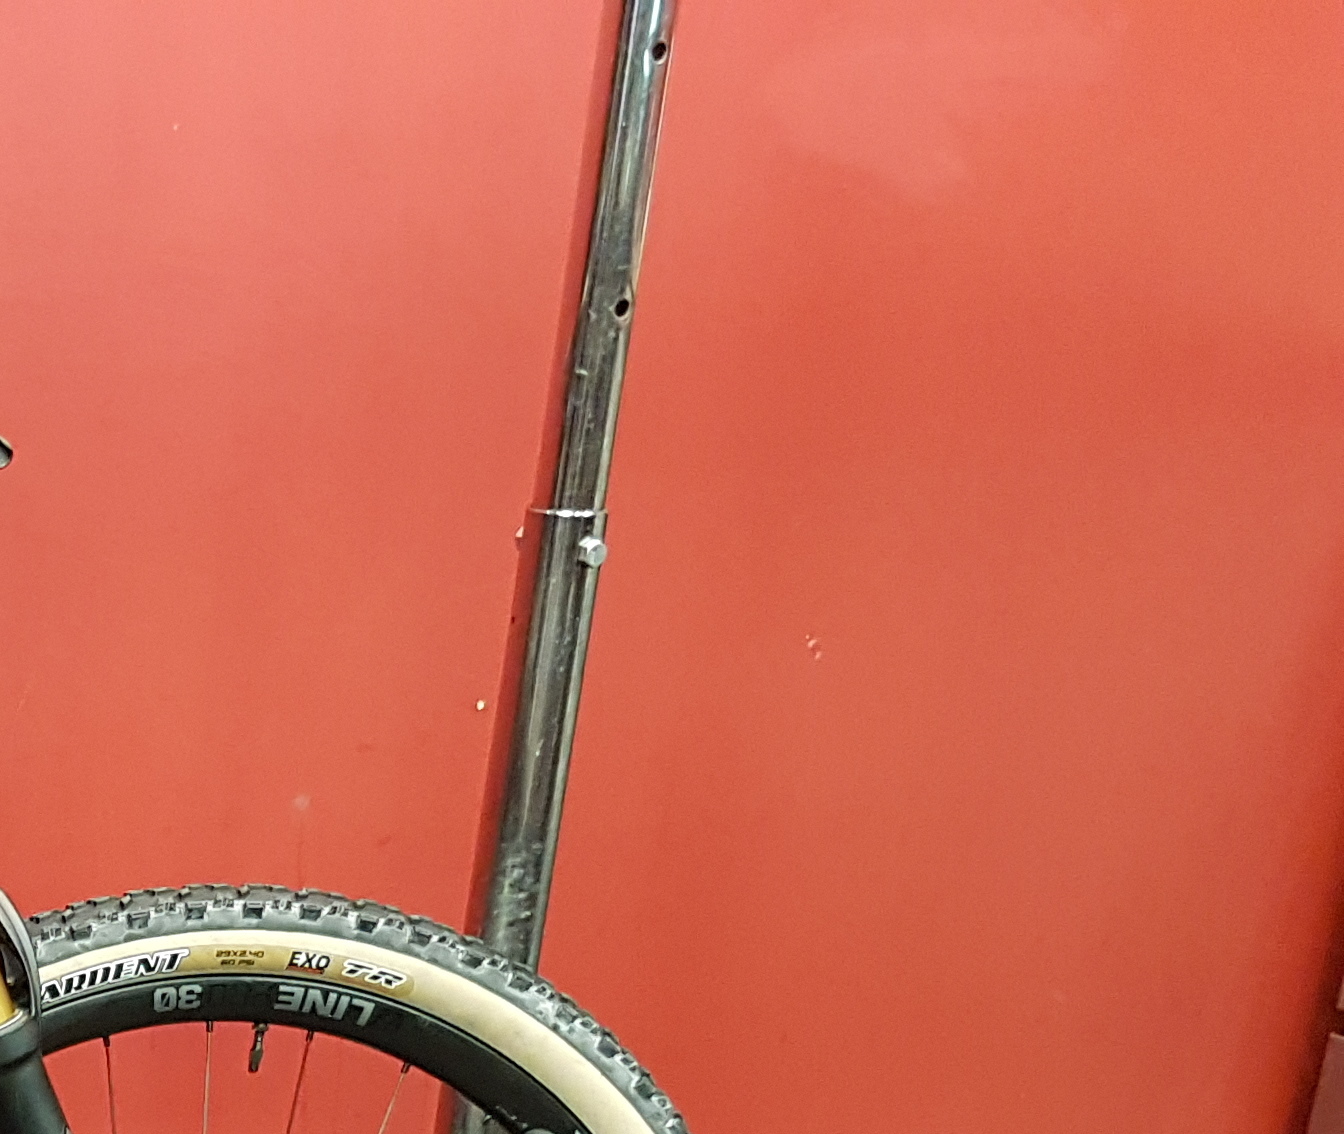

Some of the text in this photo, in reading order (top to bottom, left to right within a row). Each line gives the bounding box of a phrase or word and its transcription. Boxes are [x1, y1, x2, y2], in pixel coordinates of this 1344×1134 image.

[40, 949, 190, 1003] ARDENT
[287, 950, 406, 990] EXO TR
[153, 985, 376, 1027] LINE 30
